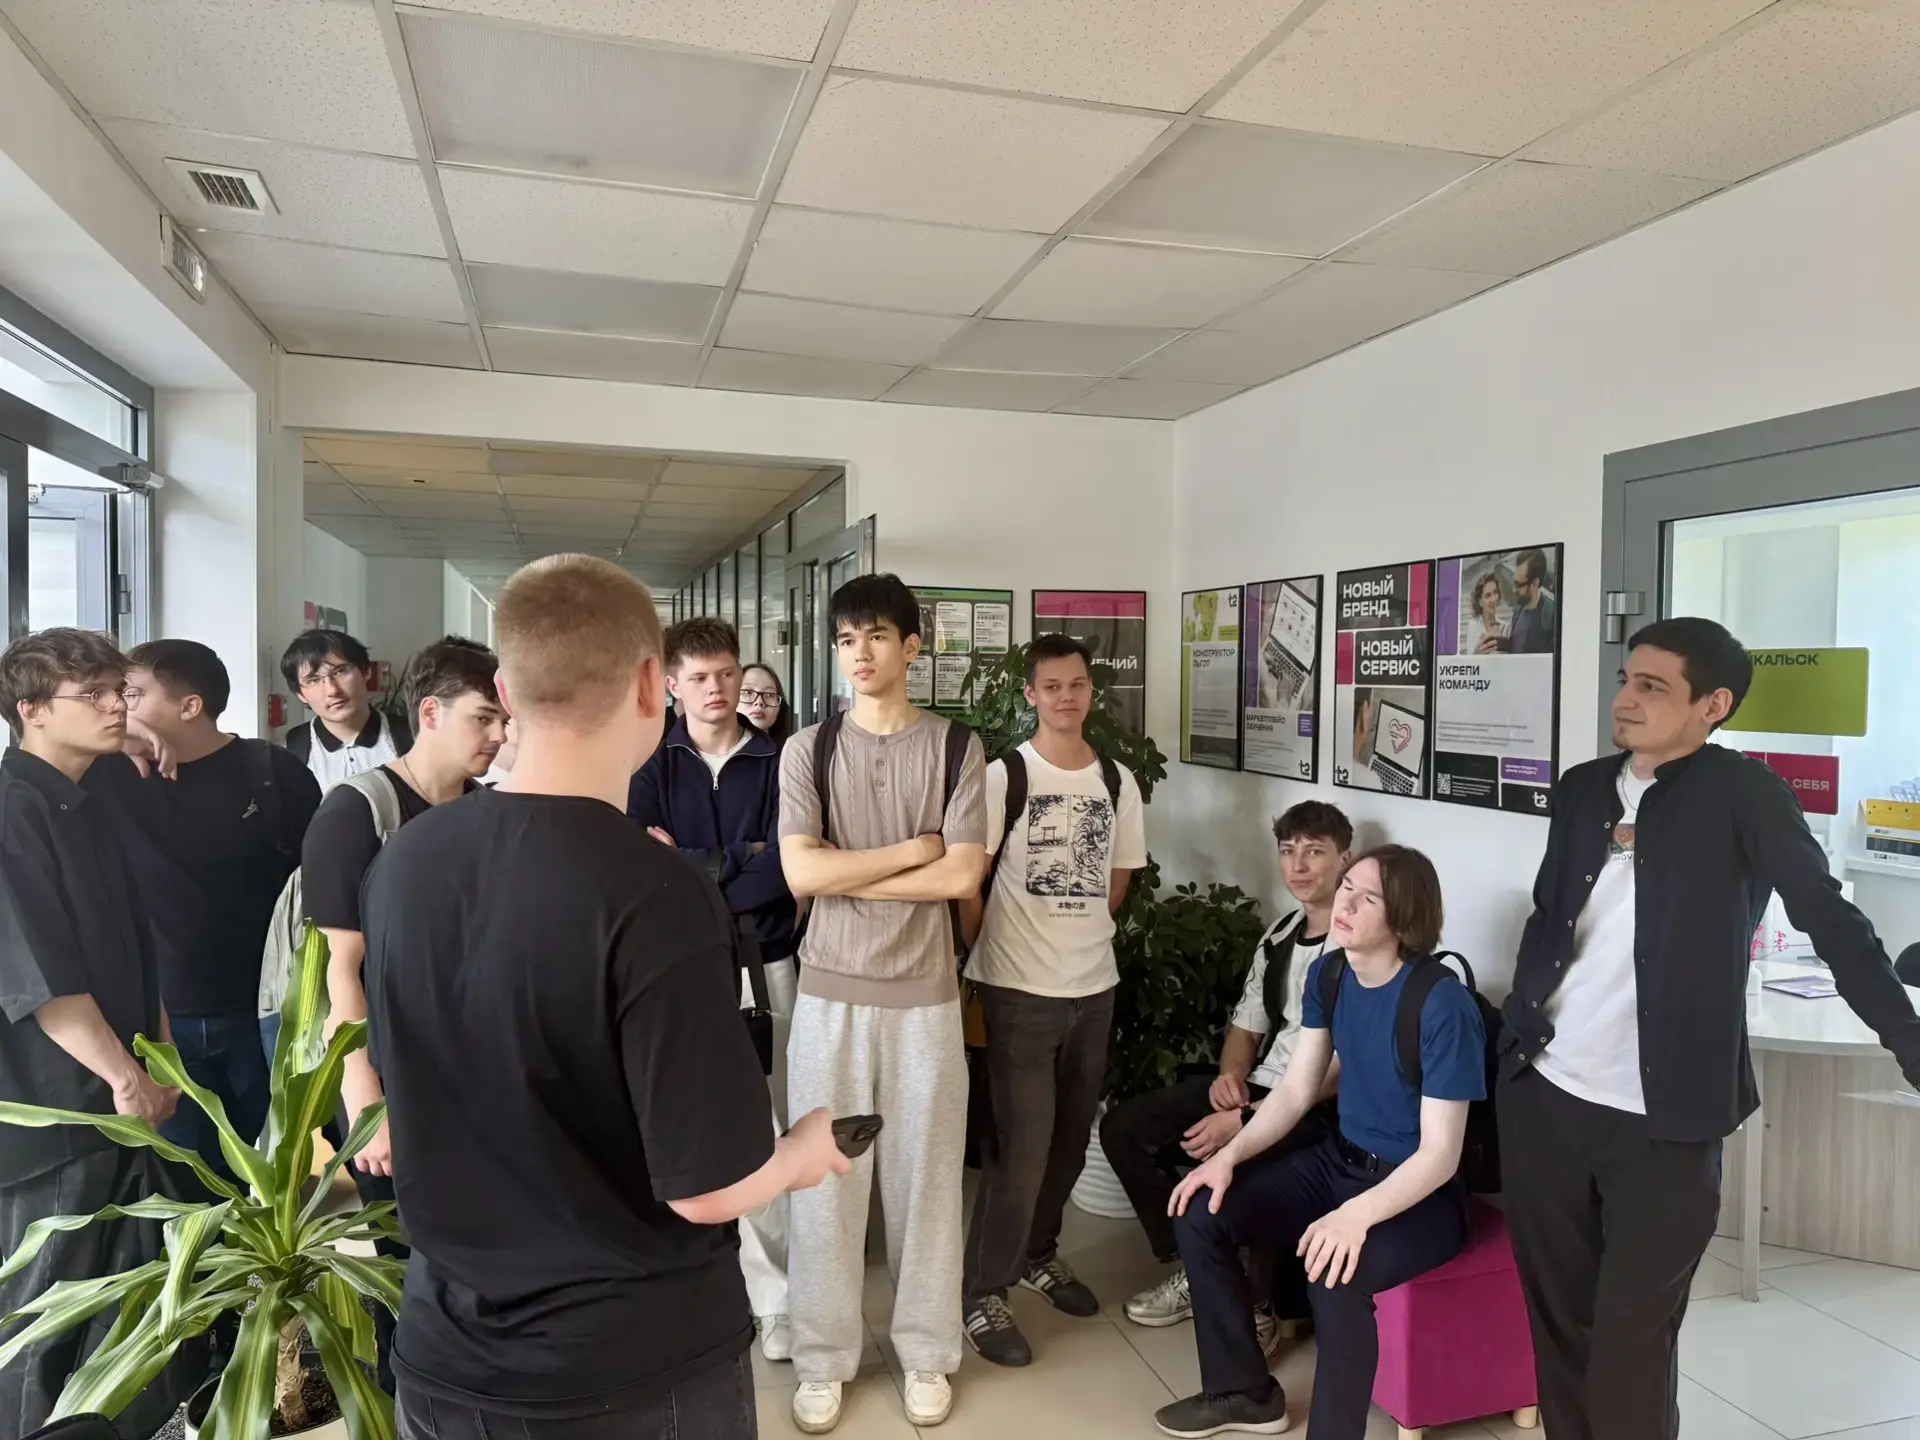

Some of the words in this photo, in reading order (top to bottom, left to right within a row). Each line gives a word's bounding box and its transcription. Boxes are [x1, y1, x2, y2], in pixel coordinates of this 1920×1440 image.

[1342, 574, 1394, 599] НОВЫЙ
[1342, 599, 1390, 618] БРЕНД
[1360, 634, 1413, 656] НОВЫЙ
[1192, 649, 1236, 658] КОНСТРУКТОР
[1360, 658, 1421, 676] СЕРВИС
[1439, 665, 1480, 676] УКРЕПИ
[1439, 679, 1491, 692] КОМАНДУ
[1246, 714, 1286, 725] МАРКЕТПЛЕЙС
[1246, 722, 1274, 732] ОБУЧЕНИЯ
[1792, 778, 1830, 791] СЕБЯ
